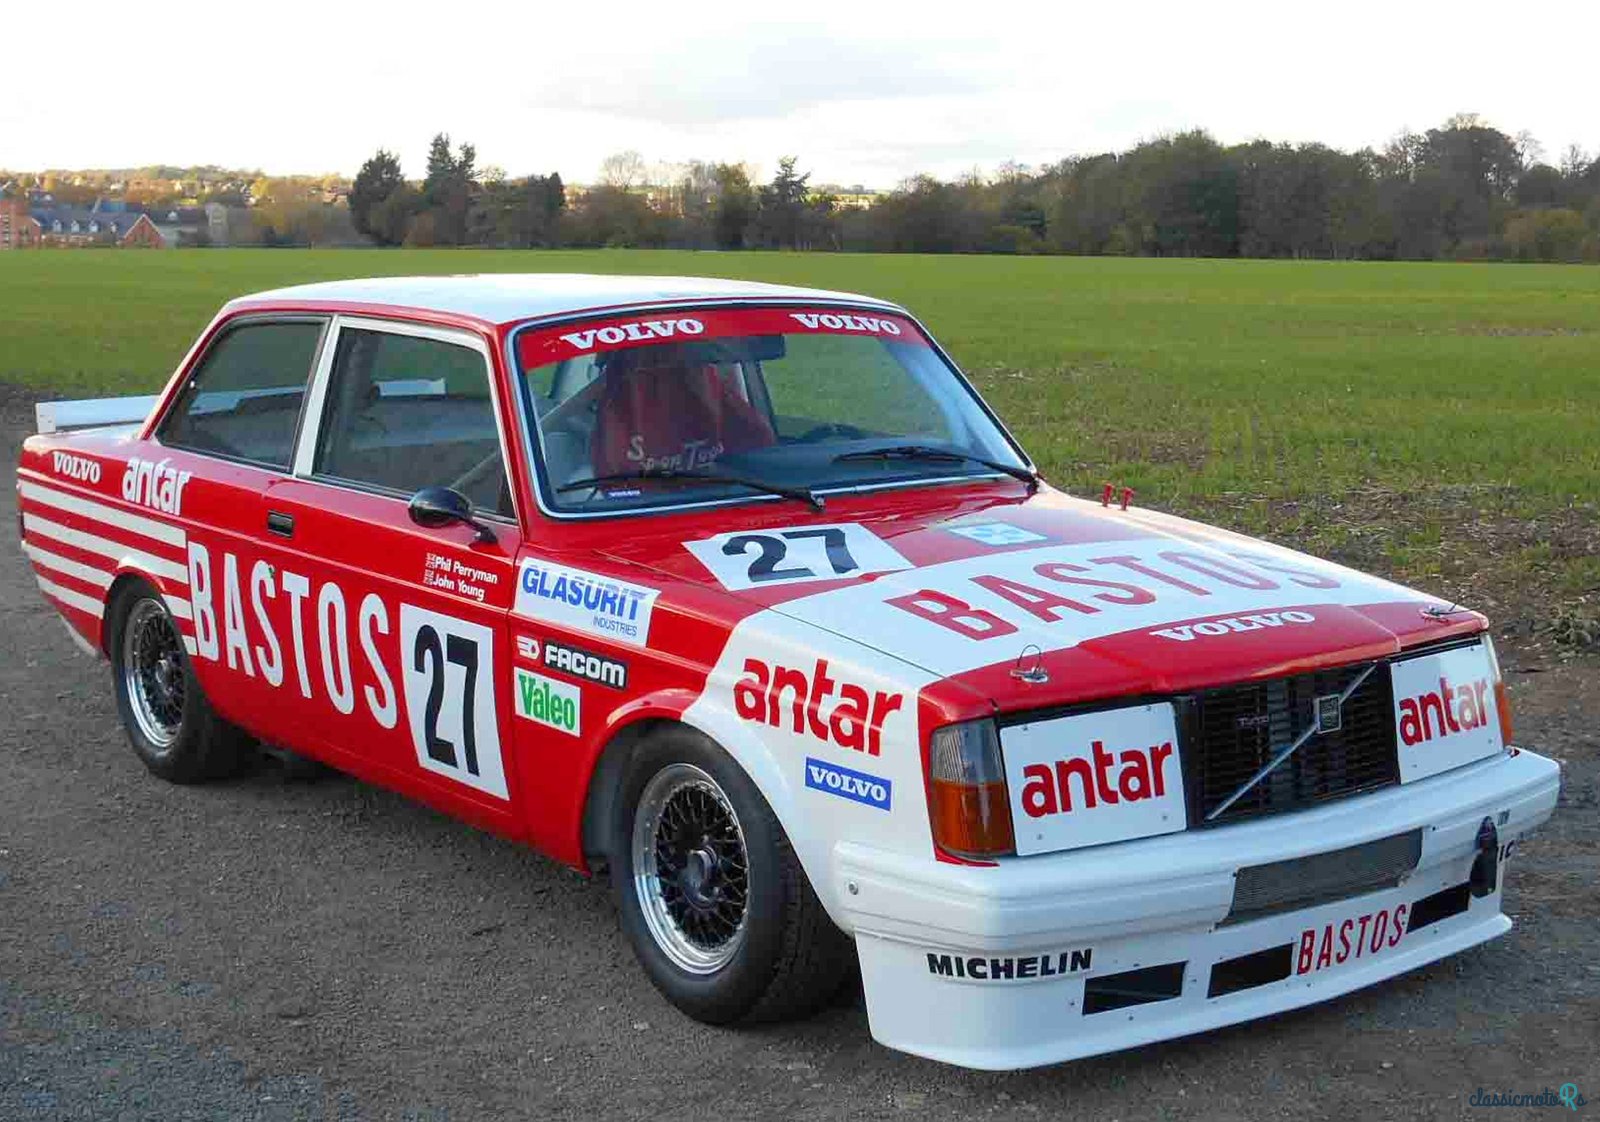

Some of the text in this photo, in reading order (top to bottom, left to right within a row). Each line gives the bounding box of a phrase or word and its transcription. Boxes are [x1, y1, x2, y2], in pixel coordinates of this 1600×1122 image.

[560, 319, 704, 350] VOLVO
[790, 313, 901, 335] VOLVO
[52, 450, 101, 484] VOLVO
[122, 456, 191, 516] antar
[435, 556, 498, 584] Phil Perryman
[721, 527, 860, 583] 27
[433, 574, 485, 601] John Young
[522, 564, 647, 621] GLASURIT
[883, 551, 1342, 641] BASTOS
[188, 541, 398, 729] BASTOS
[593, 615, 638, 637] INDUSTRIES
[1150, 610, 1316, 642] VOLVO
[545, 644, 625, 687] FACOM
[414, 624, 480, 777] 27
[518, 673, 576, 731] Valeo
[733, 658, 903, 756] antar
[1398, 676, 1492, 747] antar
[808, 765, 887, 801] VOLVO
[1021, 740, 1173, 818] antar
[926, 948, 1093, 979] MICHELIN
[1297, 903, 1407, 975] BASTOS
